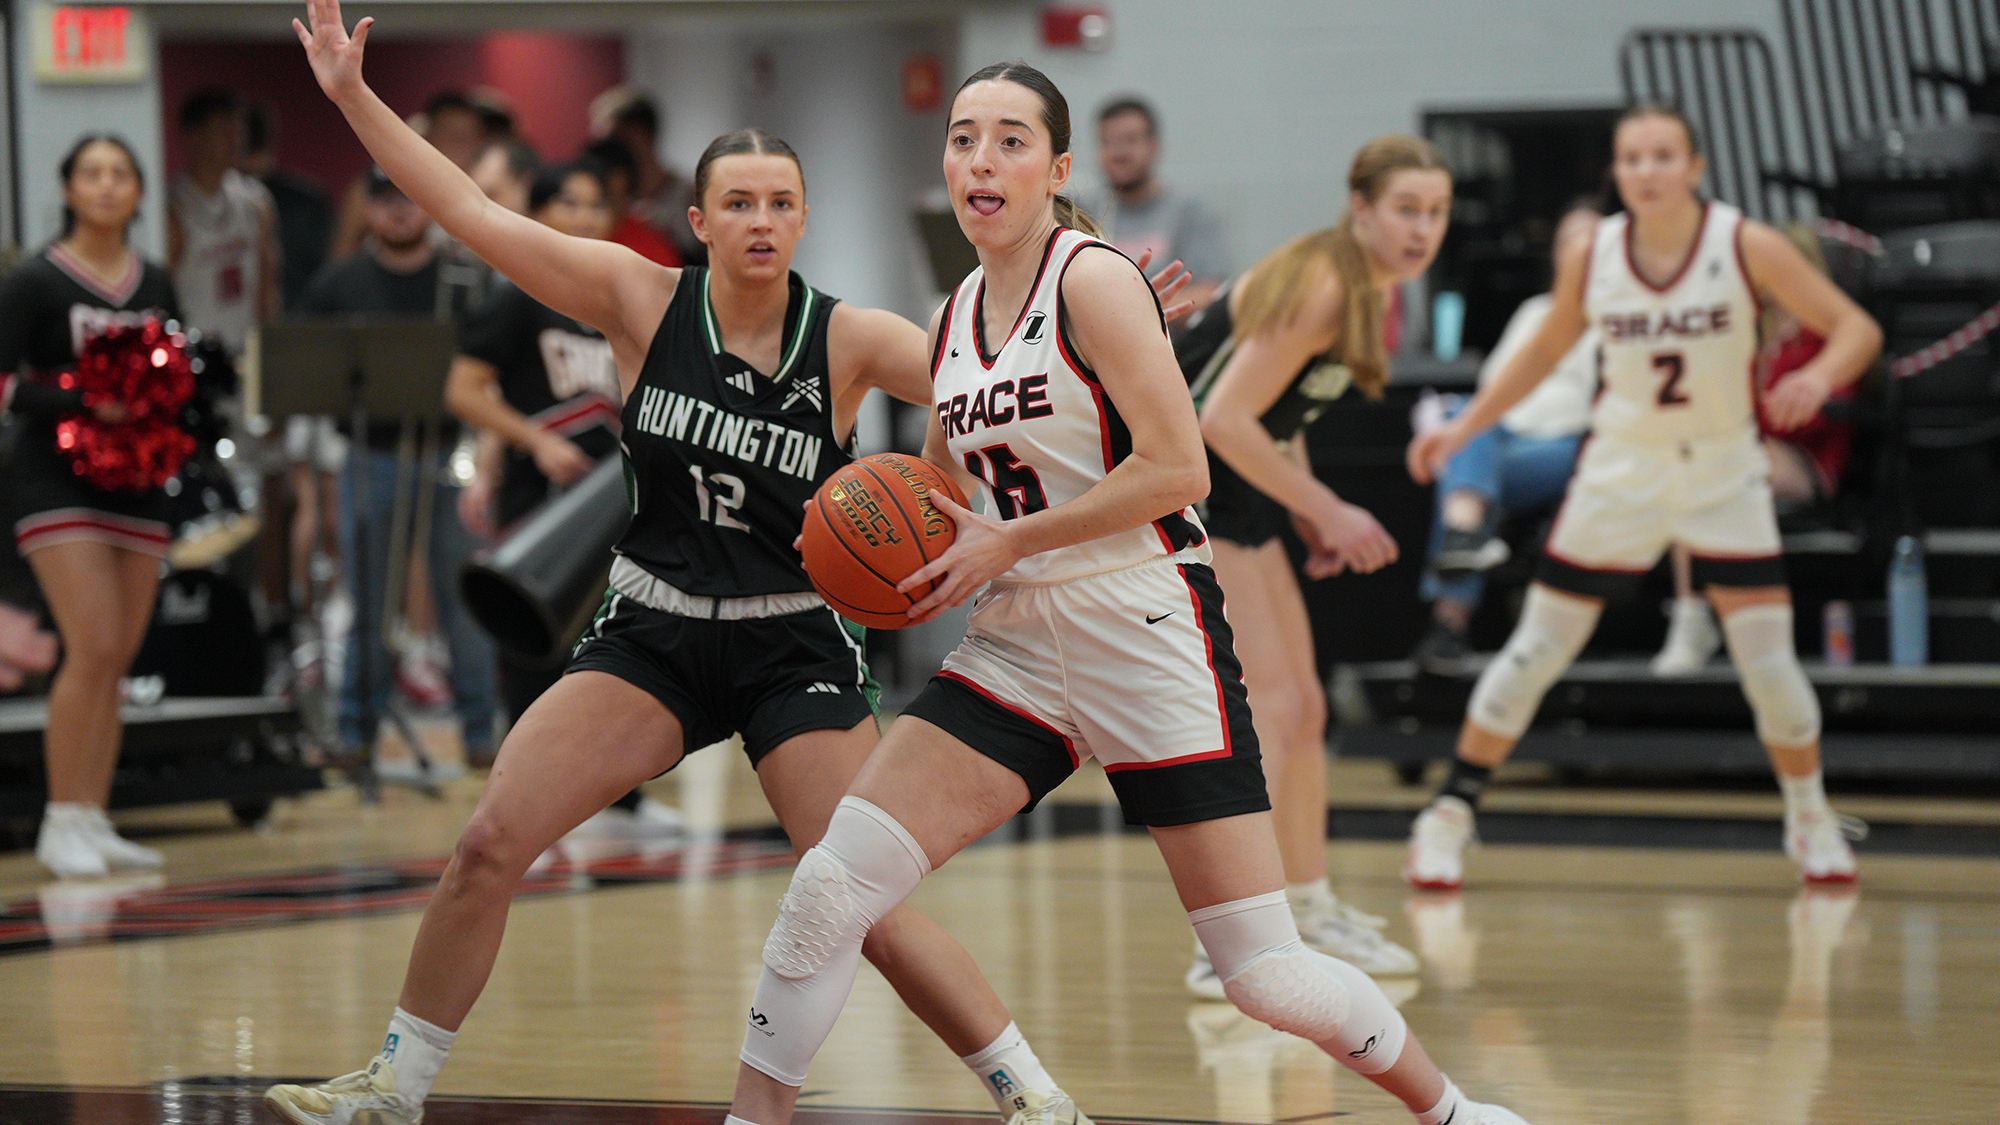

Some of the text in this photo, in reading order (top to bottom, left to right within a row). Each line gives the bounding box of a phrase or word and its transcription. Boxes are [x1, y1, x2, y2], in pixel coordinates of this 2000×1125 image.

[937, 372, 1055, 442] GRACE
[1652, 355, 1691, 406] 2
[637, 385, 822, 482] HUNTINGTON
[689, 464, 750, 533] 12
[837, 469, 904, 546] LEGACY
[839, 498, 882, 548] 1000
[868, 454, 949, 540] SPALDING
